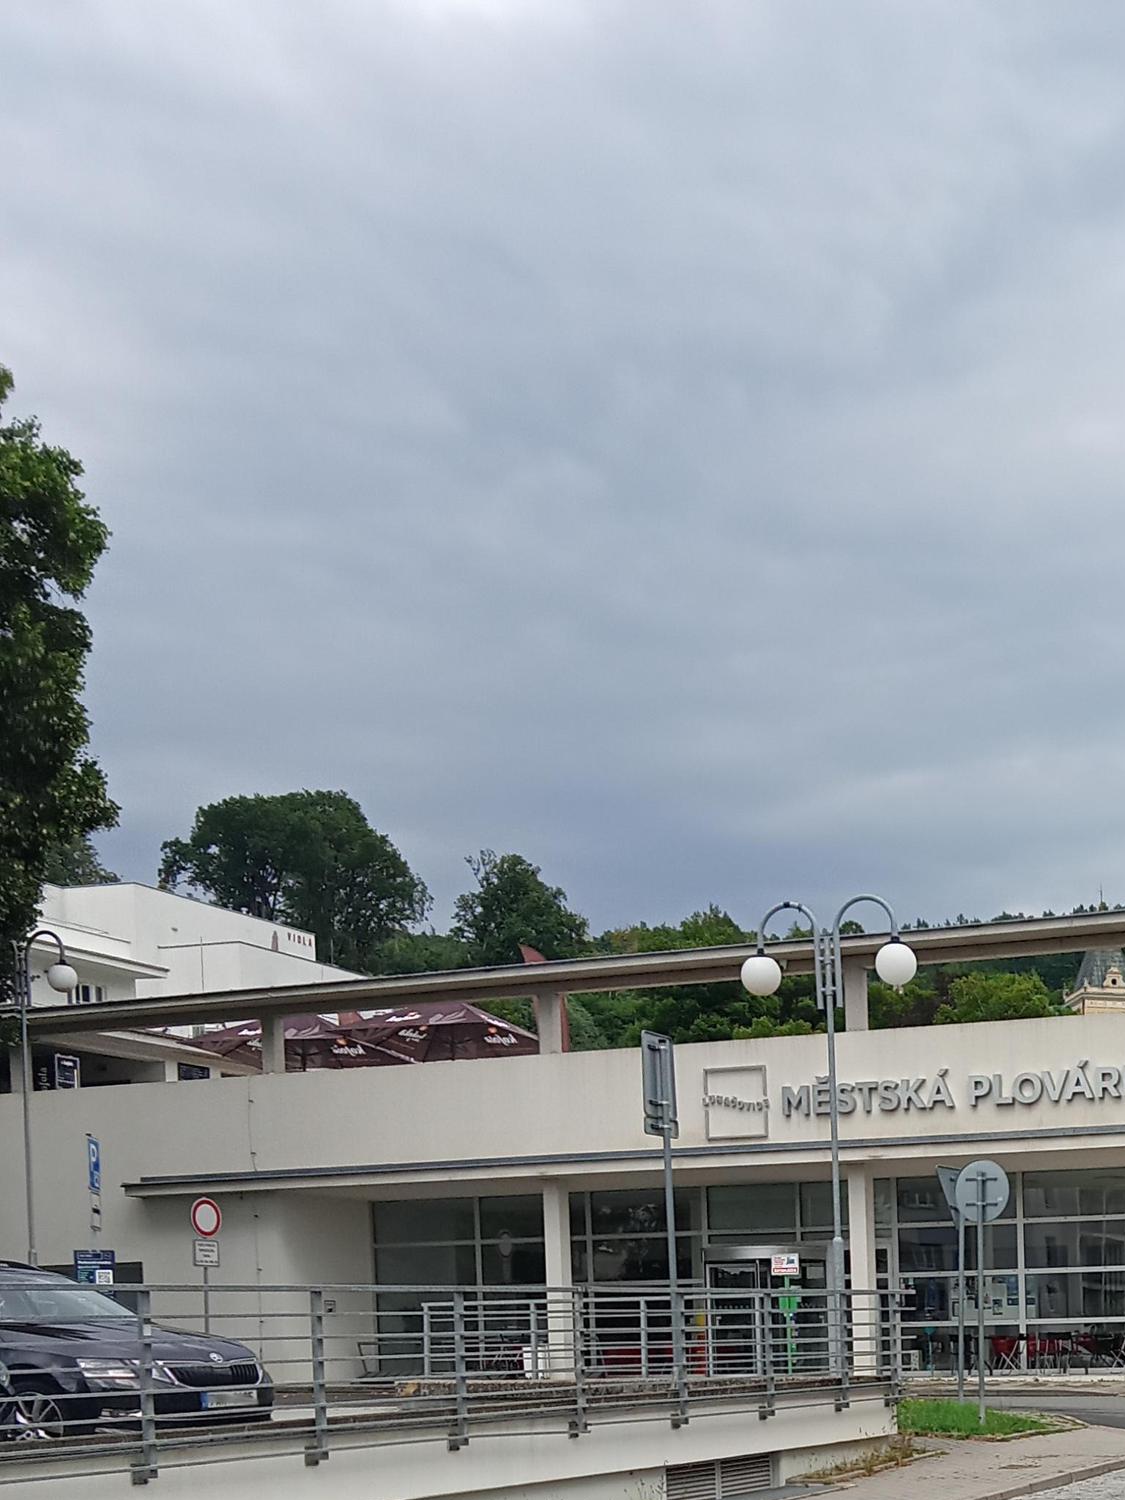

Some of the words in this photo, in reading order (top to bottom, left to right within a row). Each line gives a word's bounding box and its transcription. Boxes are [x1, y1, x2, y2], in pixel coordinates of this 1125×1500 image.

[287, 931, 313, 947] VIOLA
[781, 1067, 956, 1117] MĚSTSKÁ
[89, 1143, 98, 1171] P
